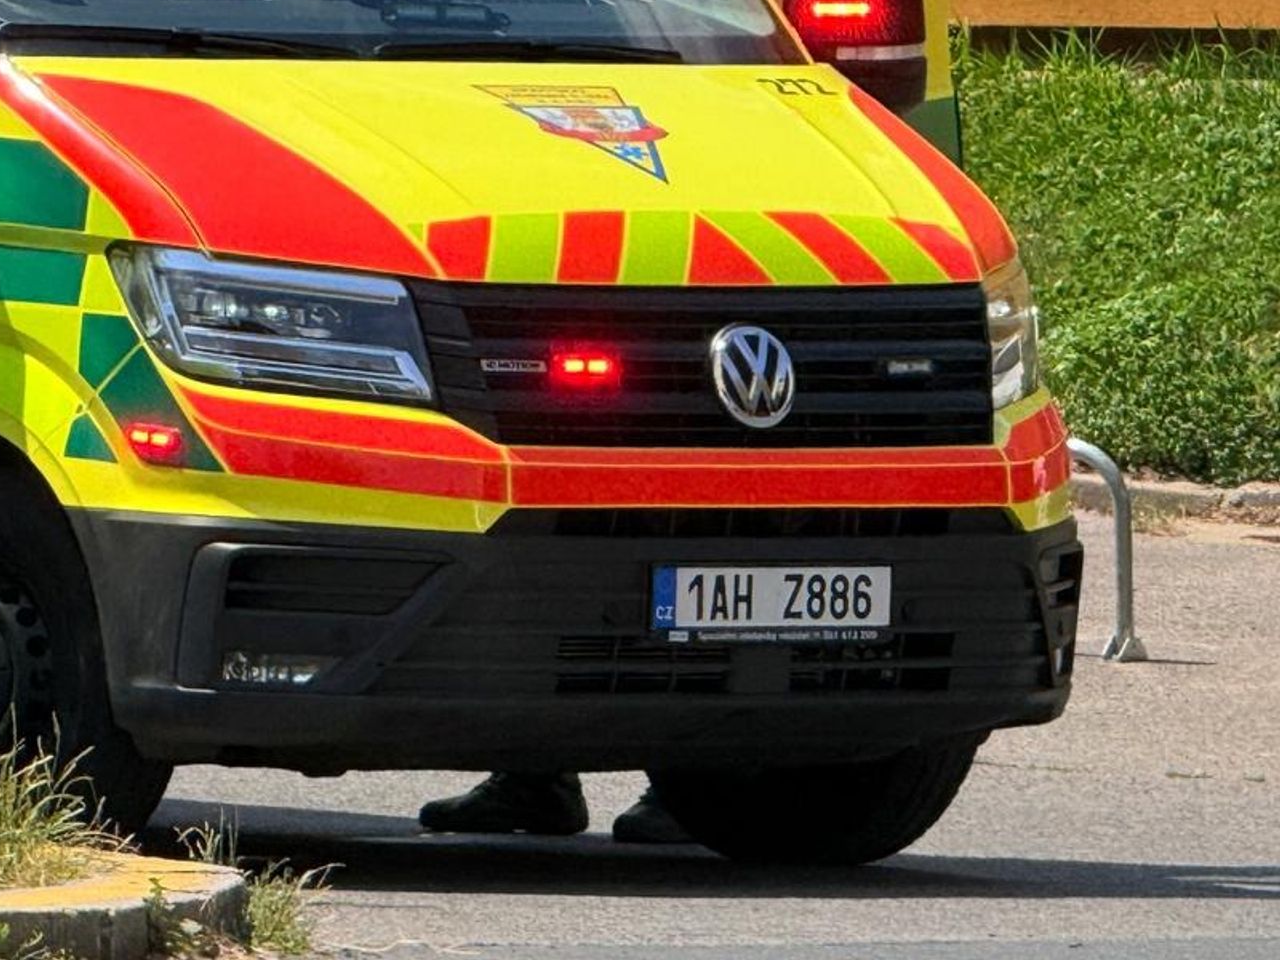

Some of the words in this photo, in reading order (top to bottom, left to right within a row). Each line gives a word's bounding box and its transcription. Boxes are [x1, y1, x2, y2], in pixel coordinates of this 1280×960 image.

[755, 78, 838, 96] 272
[688, 574, 753, 621] 1AH
[783, 574, 872, 620] Z886
[655, 605, 673, 620] CZ
